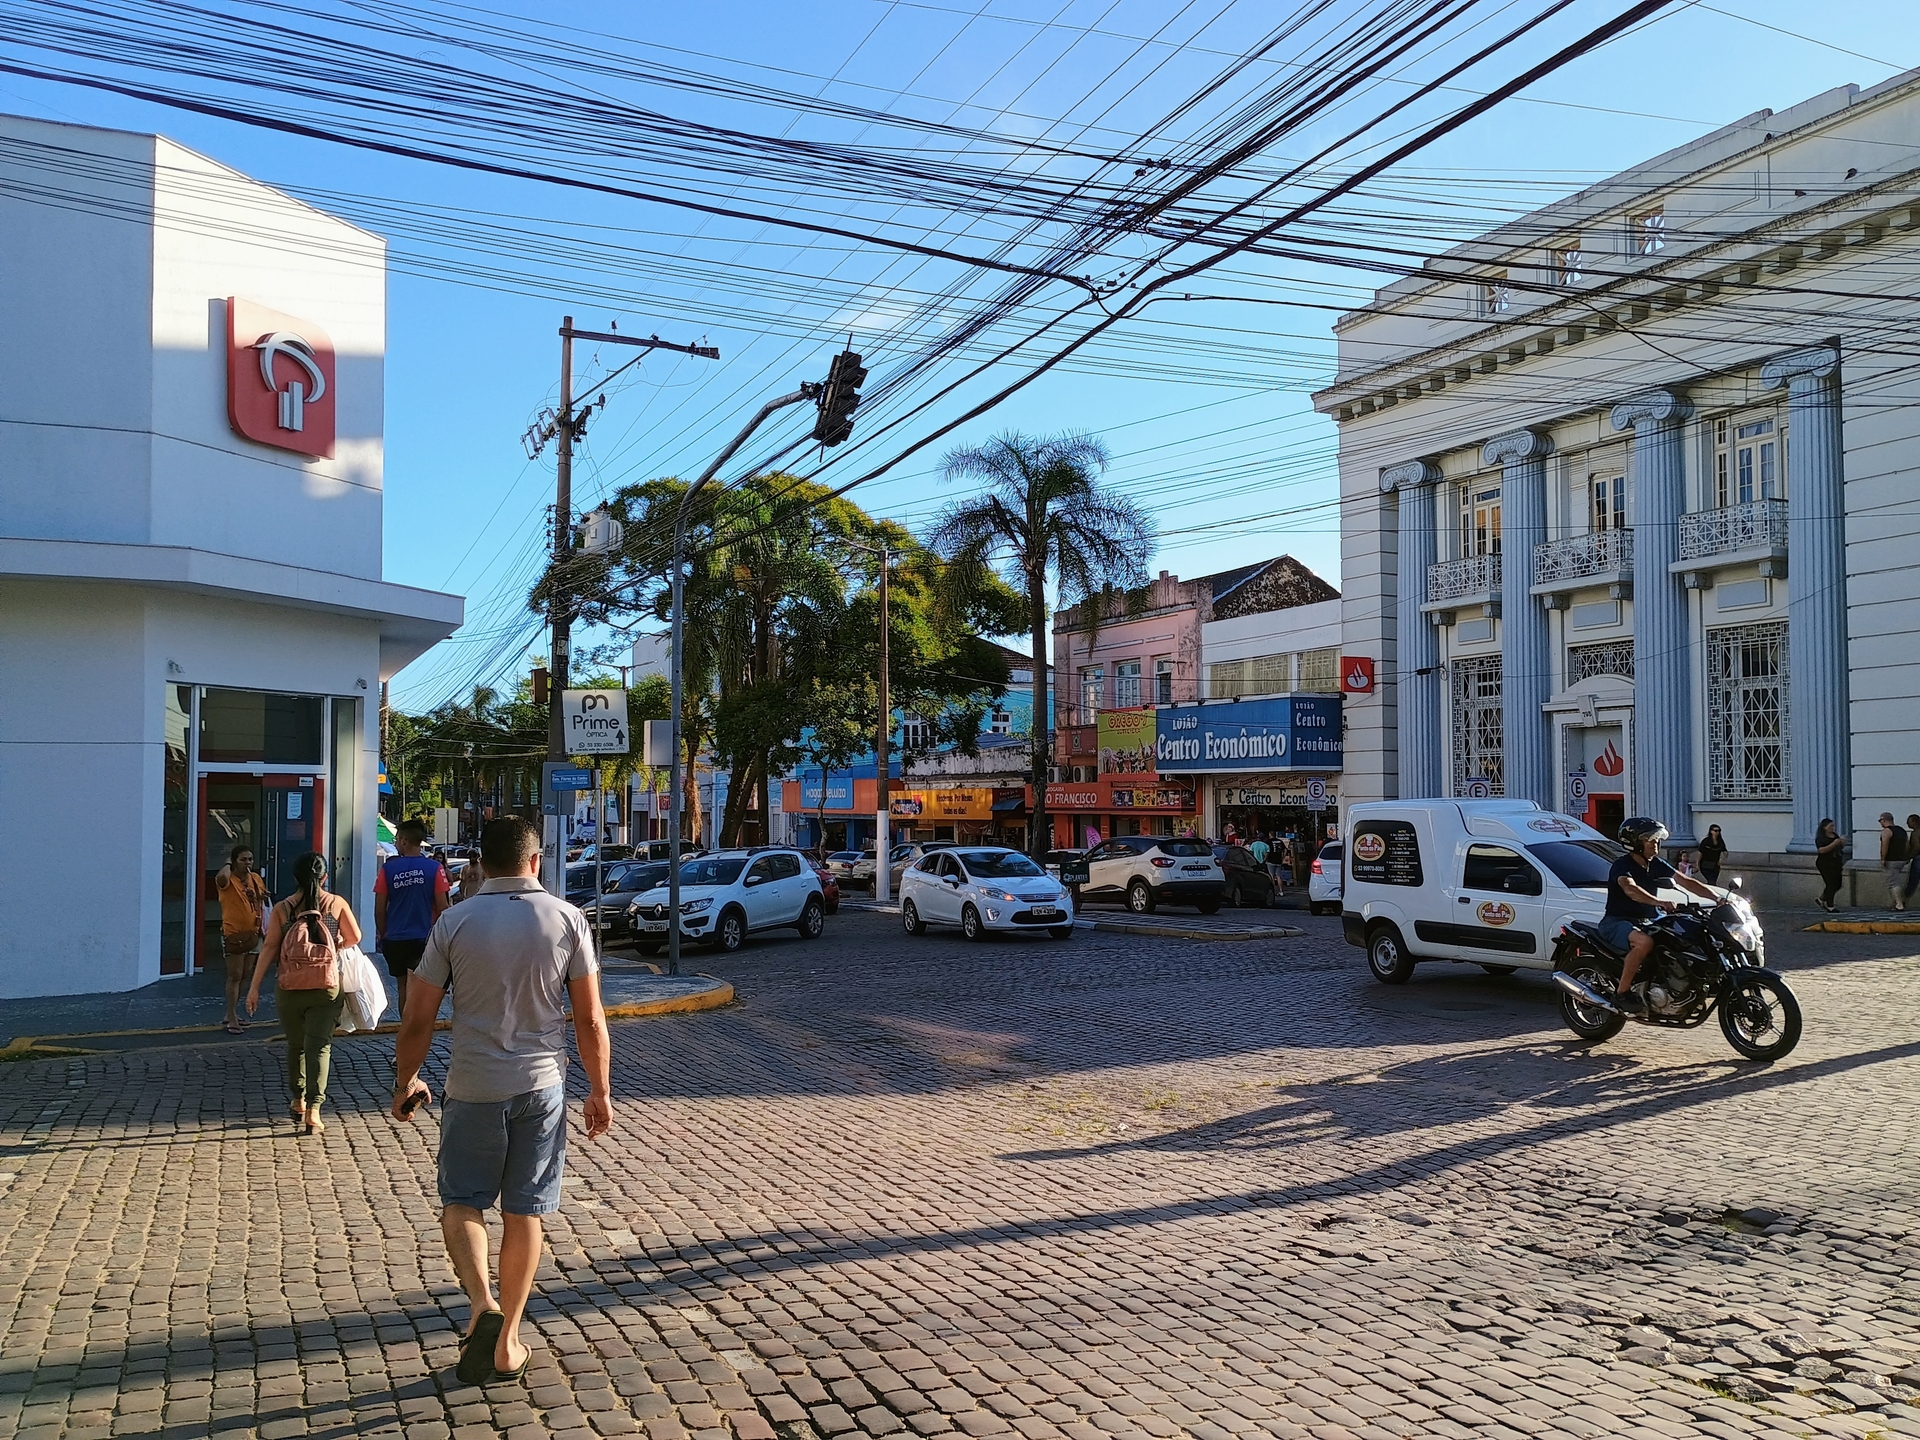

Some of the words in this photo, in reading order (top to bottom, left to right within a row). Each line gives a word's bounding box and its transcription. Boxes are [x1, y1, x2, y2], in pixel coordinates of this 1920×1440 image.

[572, 715, 620, 730] Prime
[1172, 714, 1198, 731] LOJÃO
[1295, 712, 1326, 727] Centro
[1157, 733, 1200, 761] Centro
[1205, 727, 1286, 760] Econômico
[1296, 736, 1343, 752] Econômico
[1239, 788, 1272, 805] Centro
[1279, 788, 1337, 805] Econco
[1313, 785, 1320, 795] E
[1054, 792, 1097, 804] FRANCISCO
